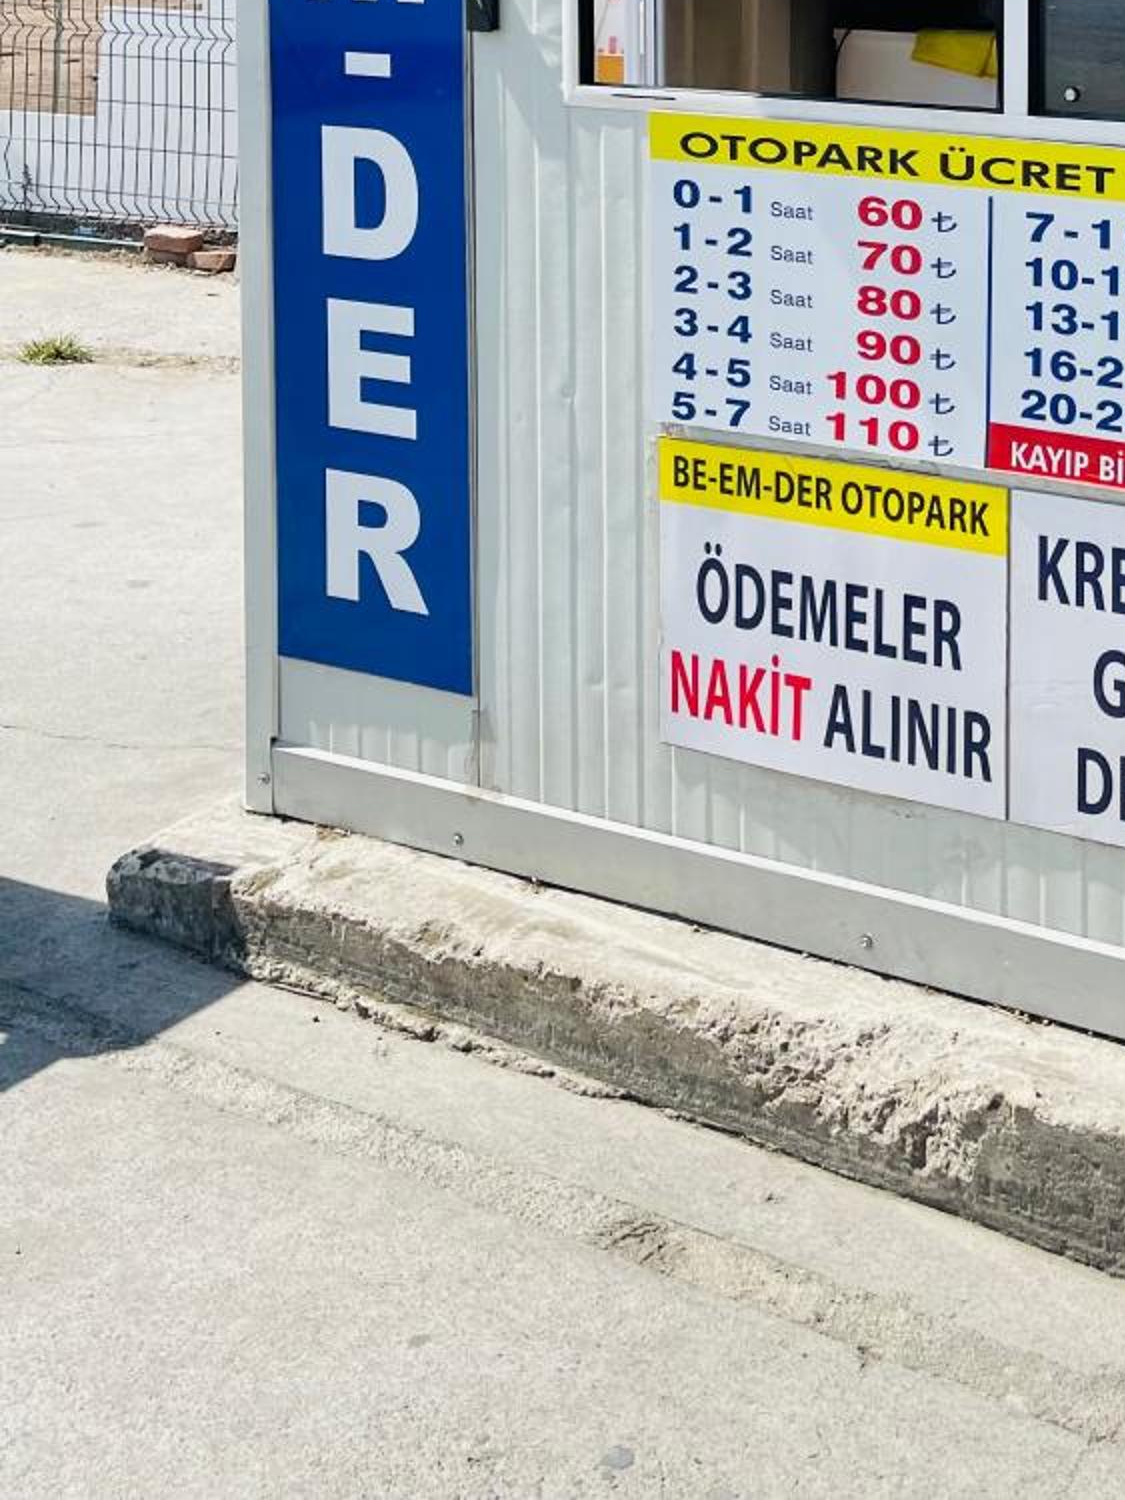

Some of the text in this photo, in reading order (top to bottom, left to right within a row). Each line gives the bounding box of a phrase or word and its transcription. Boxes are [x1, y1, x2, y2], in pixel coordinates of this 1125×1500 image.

[680, 132, 919, 177] OTOPARK
[940, 147, 1115, 194] ÜCRET
[771, 202, 813, 221] Saat
[771, 245, 813, 264] Saat
[770, 290, 813, 309] Saat
[769, 333, 813, 352] Saat
[769, 376, 812, 395] Saat
[769, 417, 812, 437] Saat
[1010, 441, 1089, 482] KAYIP
[672, 455, 988, 537] BE-EM-DER OTOPARK
[696, 542, 962, 671] ÖDEMELER
[670, 650, 992, 783] NAKİT ALINIR
